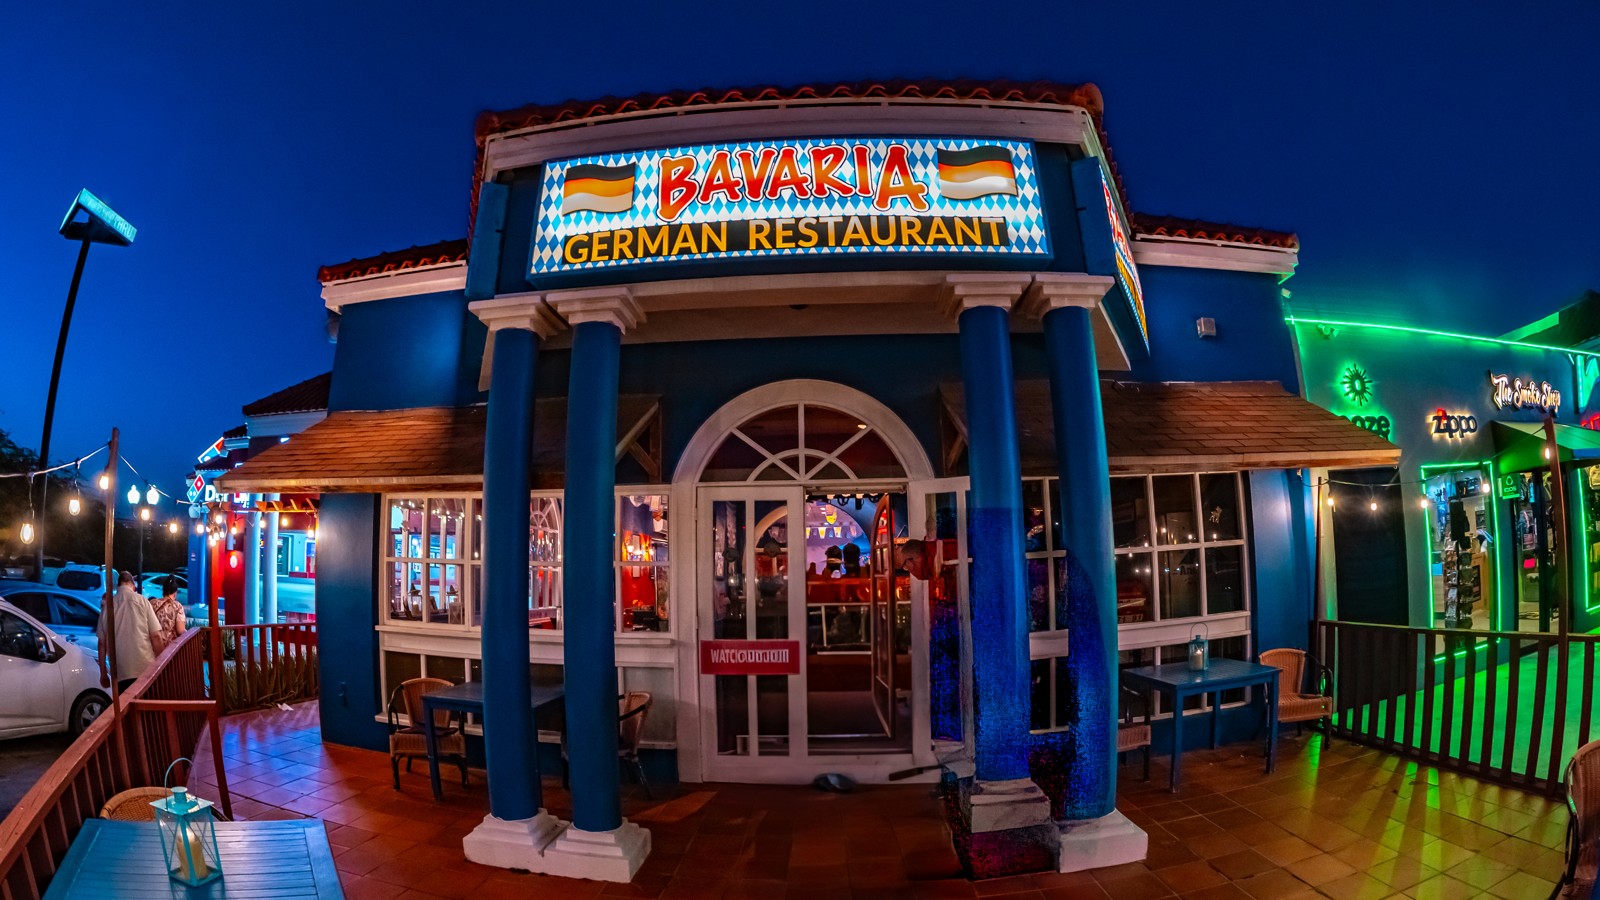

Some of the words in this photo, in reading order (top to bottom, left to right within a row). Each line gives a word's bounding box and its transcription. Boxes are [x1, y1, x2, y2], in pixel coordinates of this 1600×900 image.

[657, 144, 930, 222] BAVARIA
[564, 220, 728, 264] GERMAN
[748, 215, 1005, 251] RESTAURANT
[1490, 372, 1513, 409] The
[1514, 378, 1540, 408] Smoke
[1541, 381, 1560, 413] Shop
